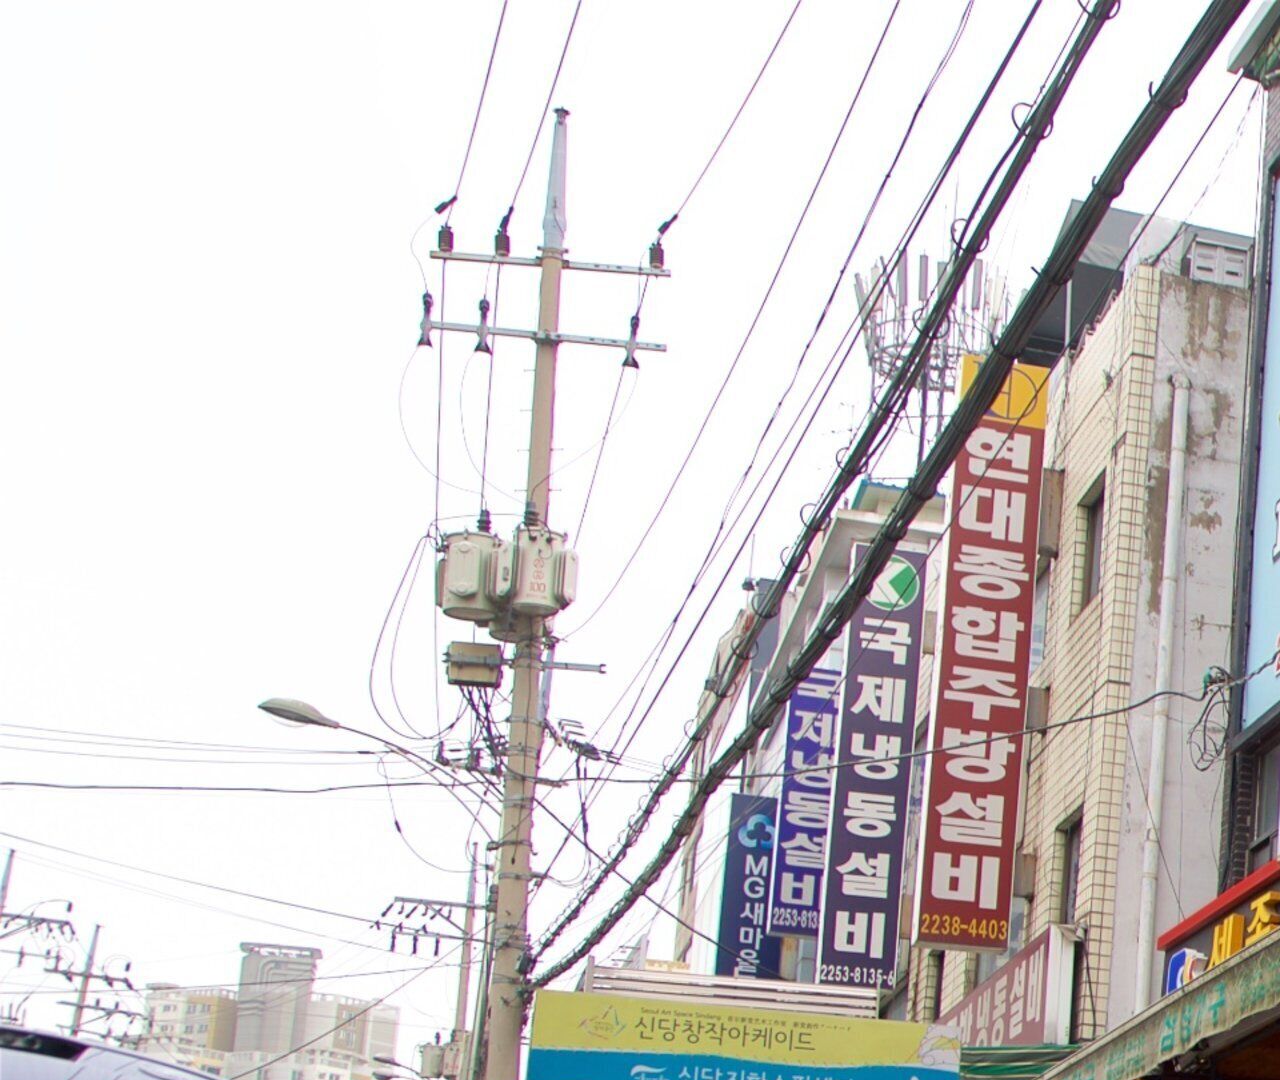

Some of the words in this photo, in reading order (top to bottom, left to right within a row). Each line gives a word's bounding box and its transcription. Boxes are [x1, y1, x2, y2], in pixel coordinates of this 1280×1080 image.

[931, 426, 1031, 911] 현대종합주방설비
[834, 617, 912, 960] 국제냉동설비
[772, 906, 820, 930] 2253-813
[920, 914, 1009, 940] 2238-4403
[634, 1015, 816, 1052] 신당창작아케이드
